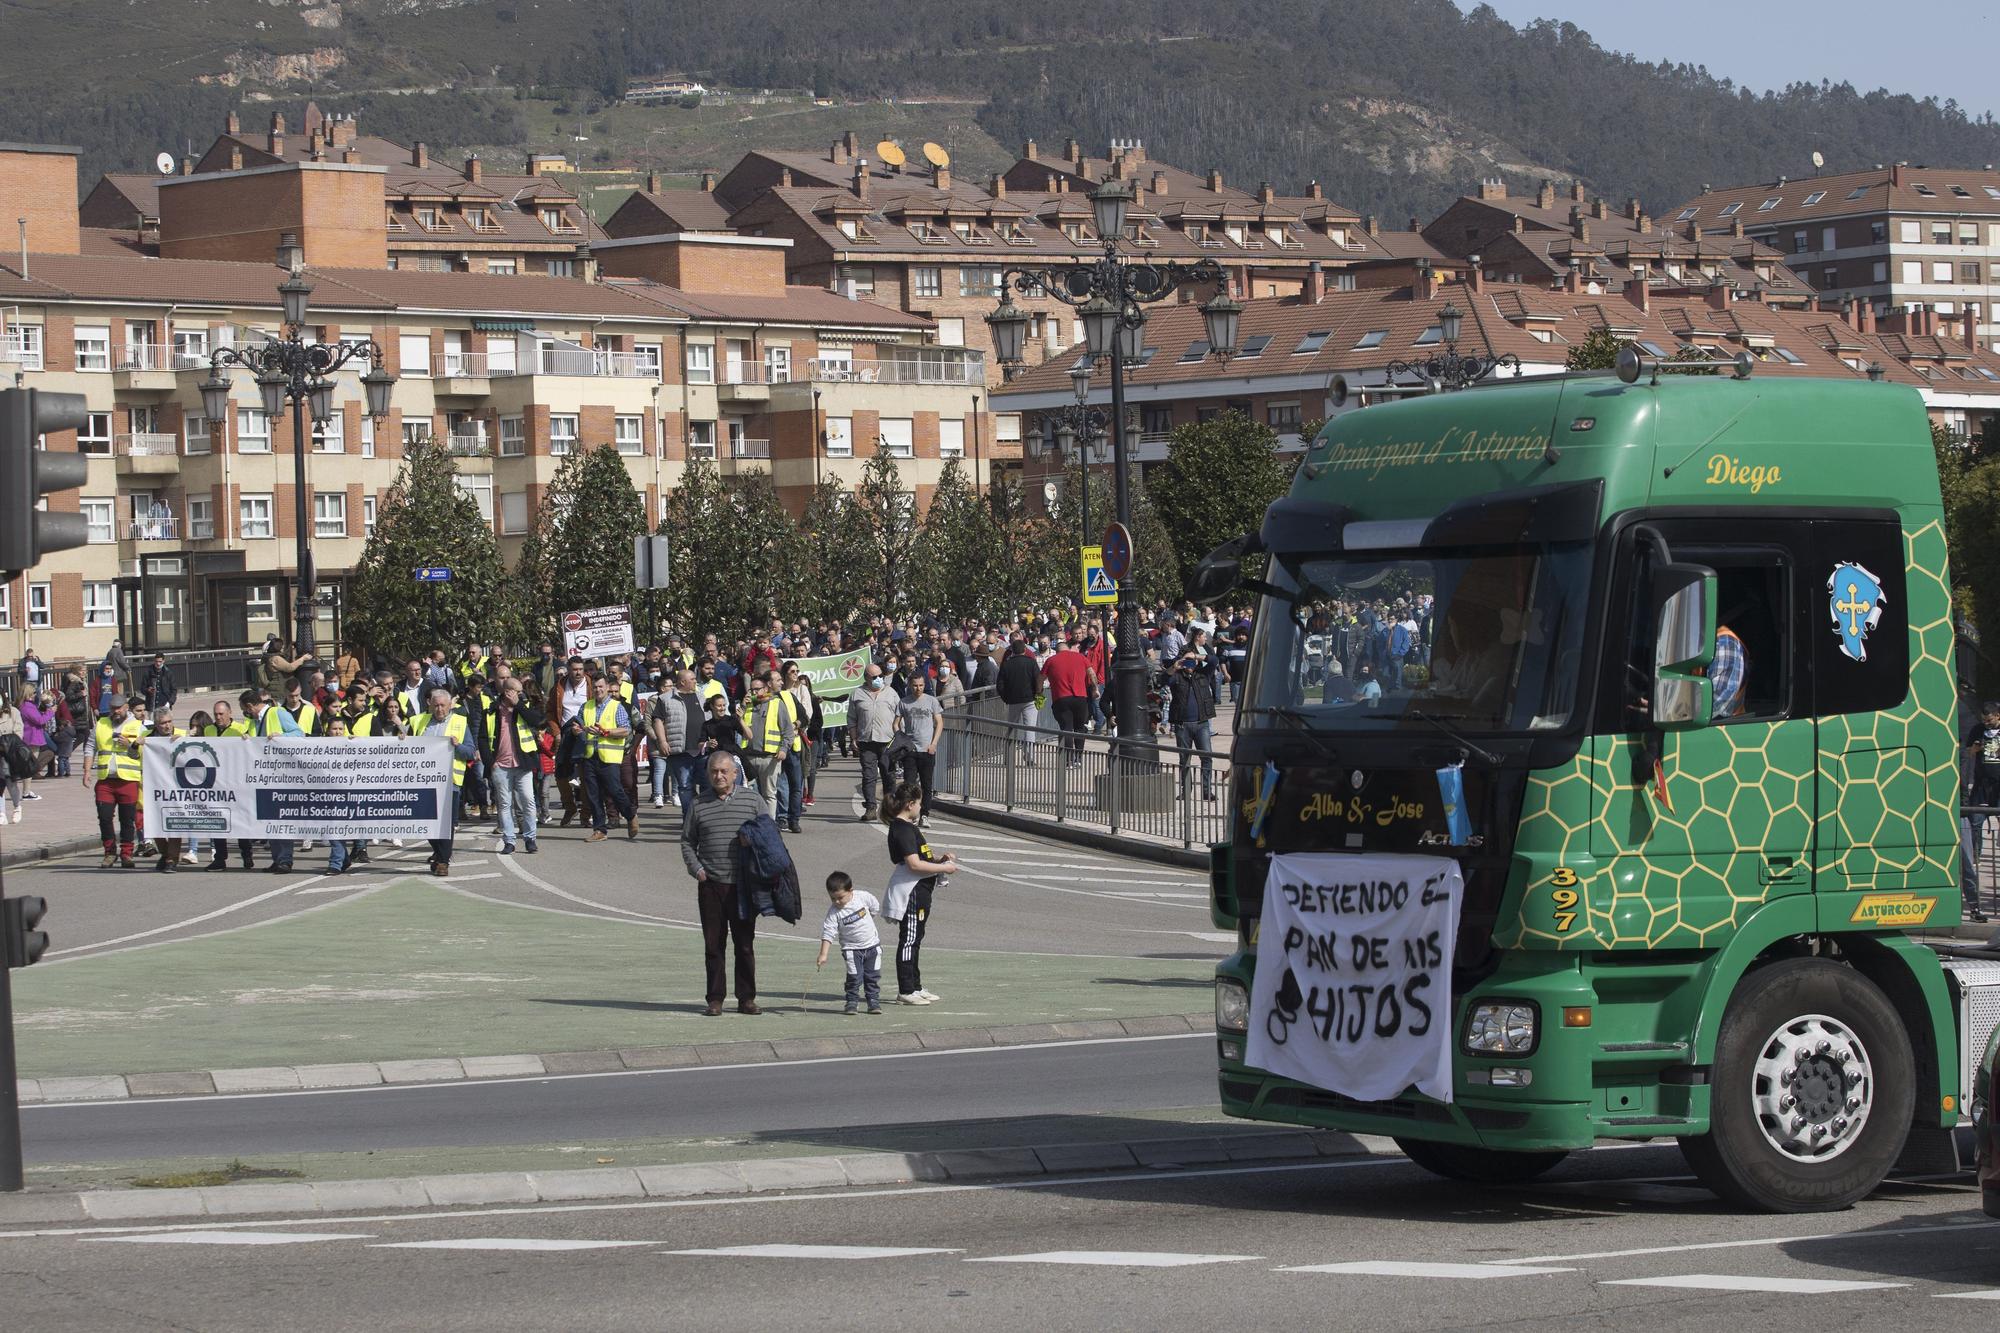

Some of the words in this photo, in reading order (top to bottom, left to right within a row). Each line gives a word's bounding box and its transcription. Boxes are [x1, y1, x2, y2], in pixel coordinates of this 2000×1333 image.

[1320, 435, 1424, 481] Principau
[1706, 453, 1782, 494] Diego
[581, 610, 597, 618] PARO
[598, 607, 628, 616] NACIONAL
[589, 614, 622, 623] INDEFINIDO
[799, 667, 837, 684] RIAS
[820, 700, 849, 716] ADE
[264, 745, 270, 755] El
[272, 746, 311, 757] transporte
[313, 745, 323, 755] de
[324, 745, 356, 755] Asturias
[358, 747, 367, 755] se
[369, 744, 408, 755] solidariza
[411, 746, 425, 754] con
[255, 759, 295, 771] Plataforma
[297, 759, 329, 769] Nacional
[332, 760, 341, 769] de
[343, 759, 375, 771] defensa
[377, 759, 390, 769] del
[392, 760, 419, 770] sector,
[421, 760, 436, 769] con
[246, 773, 257, 783] los
[258, 772, 305, 786] Agricultores,
[307, 773, 348, 784] Ganaderos
[349, 775, 354, 785] y
[357, 773, 402, 784] Pescadores
[404, 773, 414, 783] de
[417, 772, 447, 784] España
[154, 789, 236, 802] PLATAFORMA
[272, 791, 287, 802] Por
[288, 793, 308, 802] unos
[310, 791, 346, 802] Sectores
[347, 790, 419, 804] Imprescindibles
[279, 807, 299, 819] para
[300, 805, 308, 816] la
[310, 805, 348, 817] Sociedad
[349, 808, 355, 819] y
[356, 806, 365, 816] la
[368, 804, 412, 816] Economía
[1300, 792, 1343, 822] Alba
[1347, 796, 1371, 823] &
[1376, 795, 1424, 826] Jose
[265, 822, 296, 834] ÚNETE:
[298, 824, 428, 837] www.plataformanacional.es
[1282, 881, 1409, 915] DEFIENDO
[1861, 903, 1927, 917] ASTURCOOP
[1284, 926, 1338, 973] PAN
[1351, 934, 1389, 972] DE
[1307, 972, 1431, 1043] HIJOS
